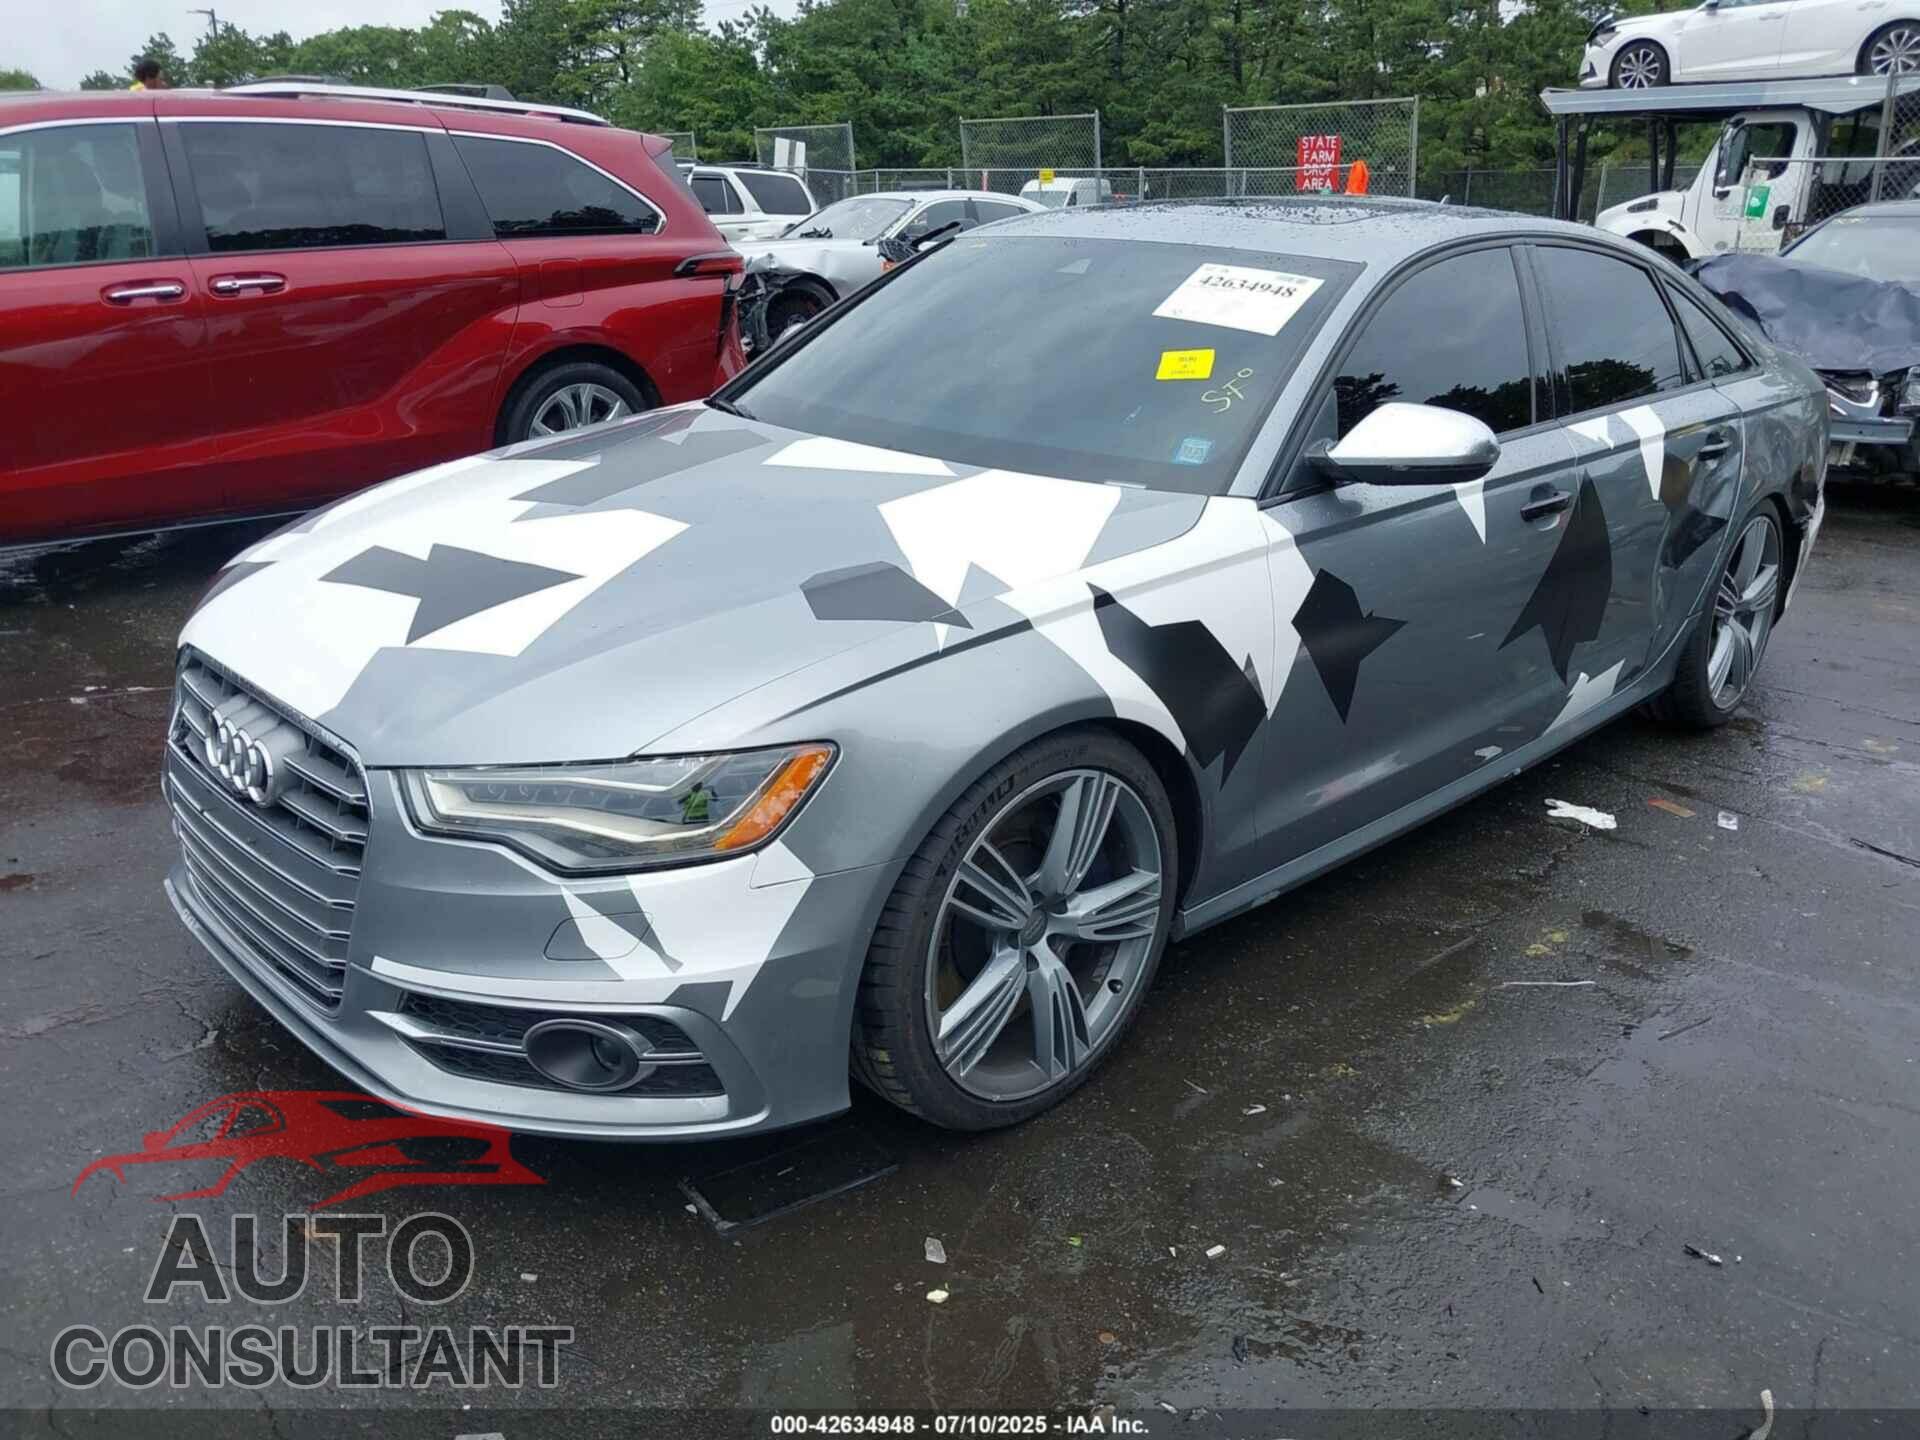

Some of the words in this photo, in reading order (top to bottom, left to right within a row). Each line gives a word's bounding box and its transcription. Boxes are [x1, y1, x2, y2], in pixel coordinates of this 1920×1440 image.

[1302, 135, 1337, 149] STATE
[1303, 150, 1335, 162] FARM
[1303, 163, 1333, 176] DROP
[1302, 178, 1333, 190] AREA
[1200, 275, 1297, 298] 42634948
